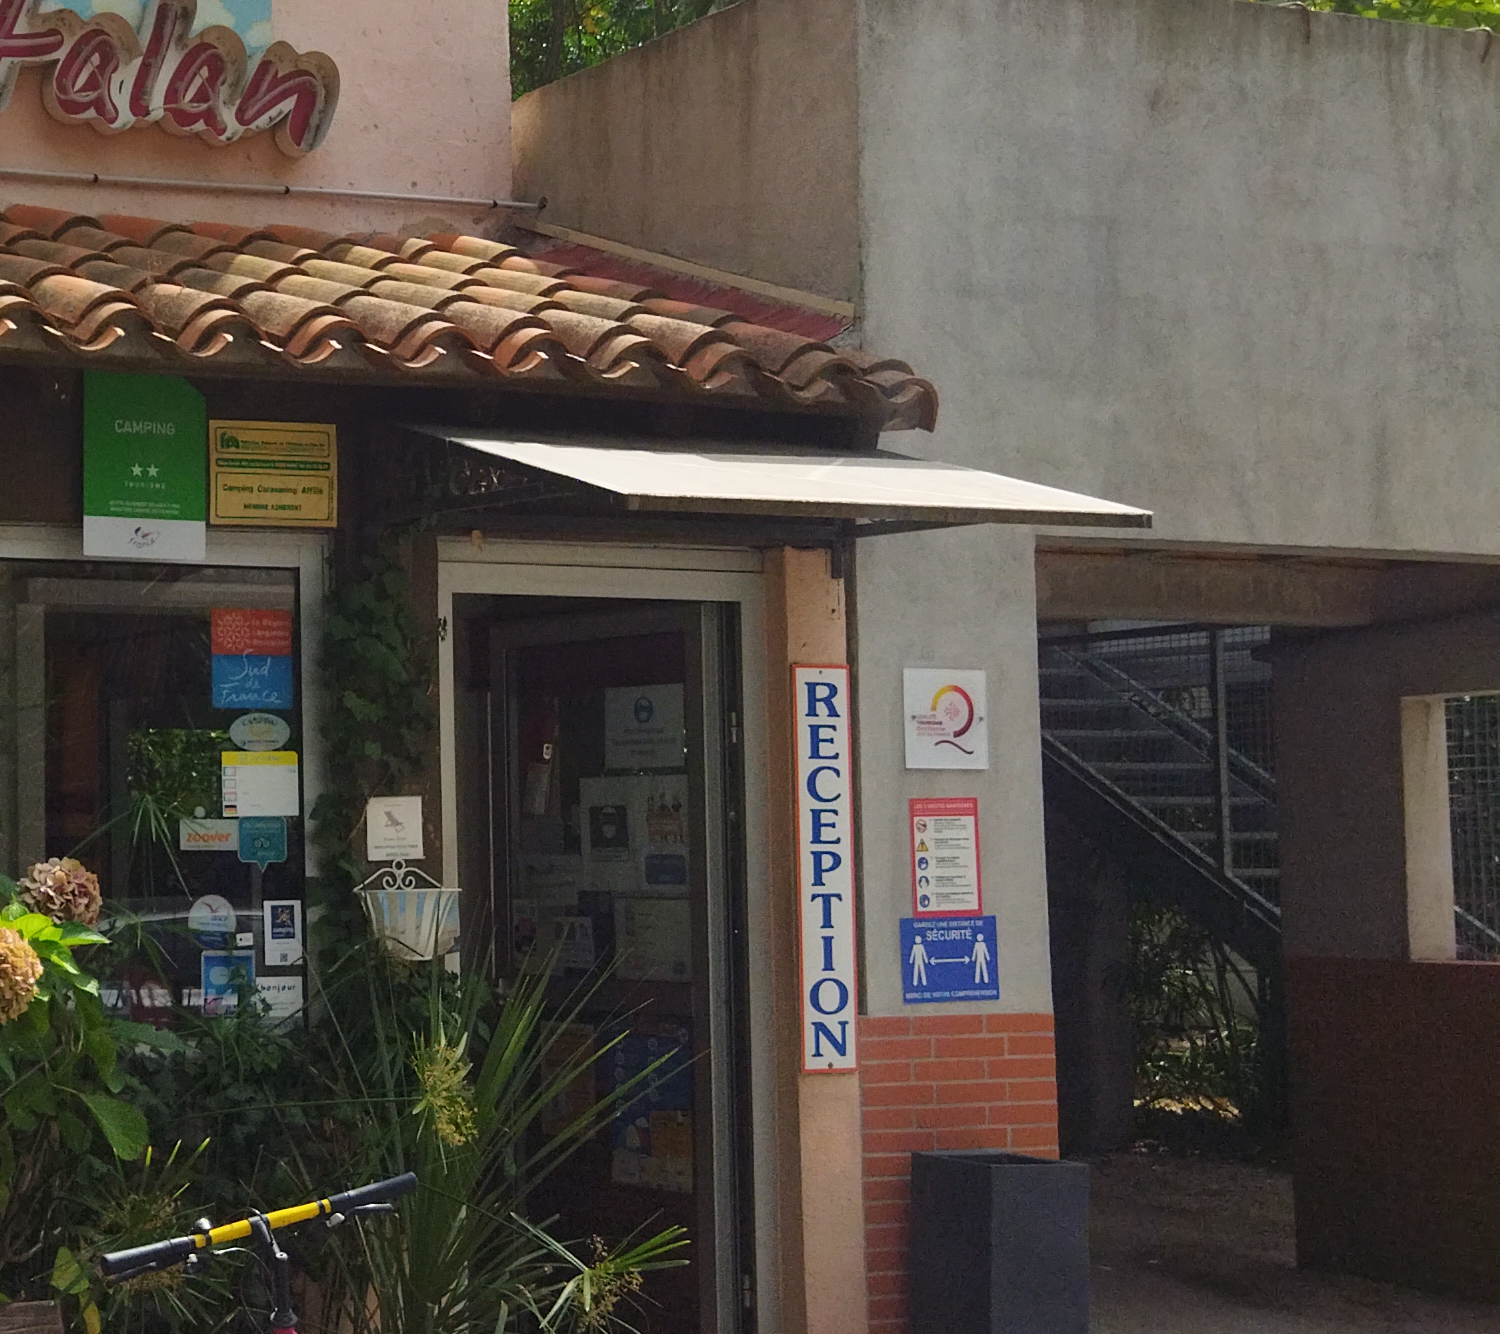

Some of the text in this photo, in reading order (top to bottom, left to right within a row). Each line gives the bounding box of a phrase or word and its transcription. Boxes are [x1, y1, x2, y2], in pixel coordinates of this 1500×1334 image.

[114, 419, 176, 436] CAMPING
[222, 483, 254, 494] Camping
[227, 648, 272, 681] Sud
[218, 682, 284, 705] France
[186, 831, 232, 843] zoover
[804, 681, 850, 1058] RECEPTION
[926, 928, 972, 941] SÉCURITÉ
[260, 983, 296, 994] bonjour
